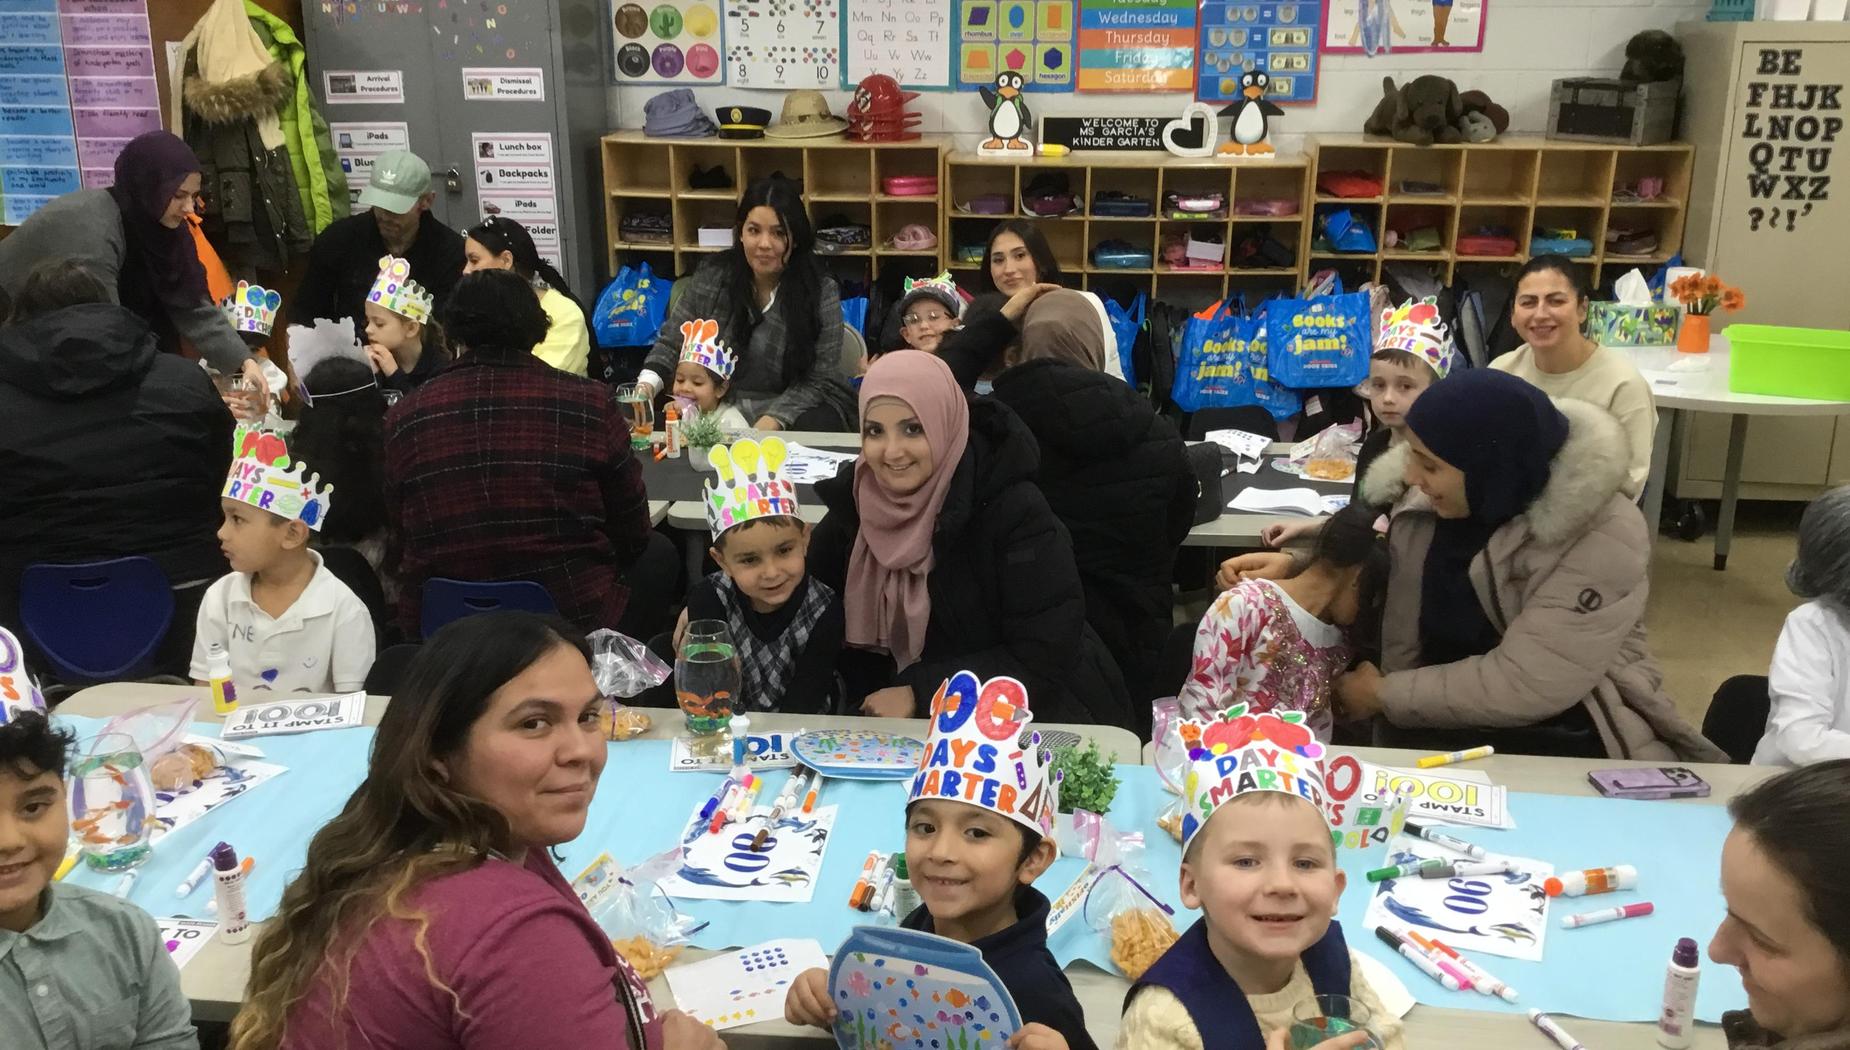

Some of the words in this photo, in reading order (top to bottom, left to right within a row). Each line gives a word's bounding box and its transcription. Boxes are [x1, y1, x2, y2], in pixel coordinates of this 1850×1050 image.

[852, 11, 873, 22] Mm
[881, 11, 897, 22] Nn
[929, 11, 944, 27] Pp
[1098, 11, 1178, 26] Wednesday
[741, 18, 750, 32] 5
[776, 20, 786, 33] 6
[816, 20, 825, 34] 7
[857, 29, 875, 46] Qq
[884, 30, 896, 41] Rr
[905, 30, 919, 41] Ss
[1105, 30, 1170, 47] Thursday
[863, 49, 879, 60] Uu
[888, 49, 900, 60] Vv
[910, 49, 932, 60] Ww
[1757, 49, 1803, 75] BE
[738, 64, 747, 78] 8
[775, 65, 784, 79] 9
[816, 66, 829, 80] 10
[914, 67, 928, 80] Zz
[1039, 72, 1067, 82] hexagon
[367, 75, 390, 83] Arrival
[500, 77, 532, 85] Dismissal
[1082, 118, 1139, 128] WELCOME
[1145, 118, 1159, 128] TO
[366, 132, 389, 141] iPads
[1079, 127, 1095, 136] MS
[499, 143, 524, 151] Lunch
[526, 143, 542, 151] box
[1072, 137, 1114, 147] KINDER
[1117, 137, 1160, 147] GARTEN
[499, 169, 549, 180] Backpacks
[515, 200, 537, 208] iPads
[1292, 313, 1345, 328] Books
[734, 481, 780, 504] DAYS
[722, 497, 797, 527] SMARTER
[233, 723, 254, 731] TO
[261, 721, 281, 729] IT
[285, 716, 344, 728] STAMP
[920, 739, 998, 774] DAYS
[1216, 747, 1300, 778] DAYS
[909, 769, 1018, 814] MARTER
[1199, 768, 1324, 819] SMARTER
[1420, 801, 1485, 817] STAMP
[173, 928, 201, 939] TO
